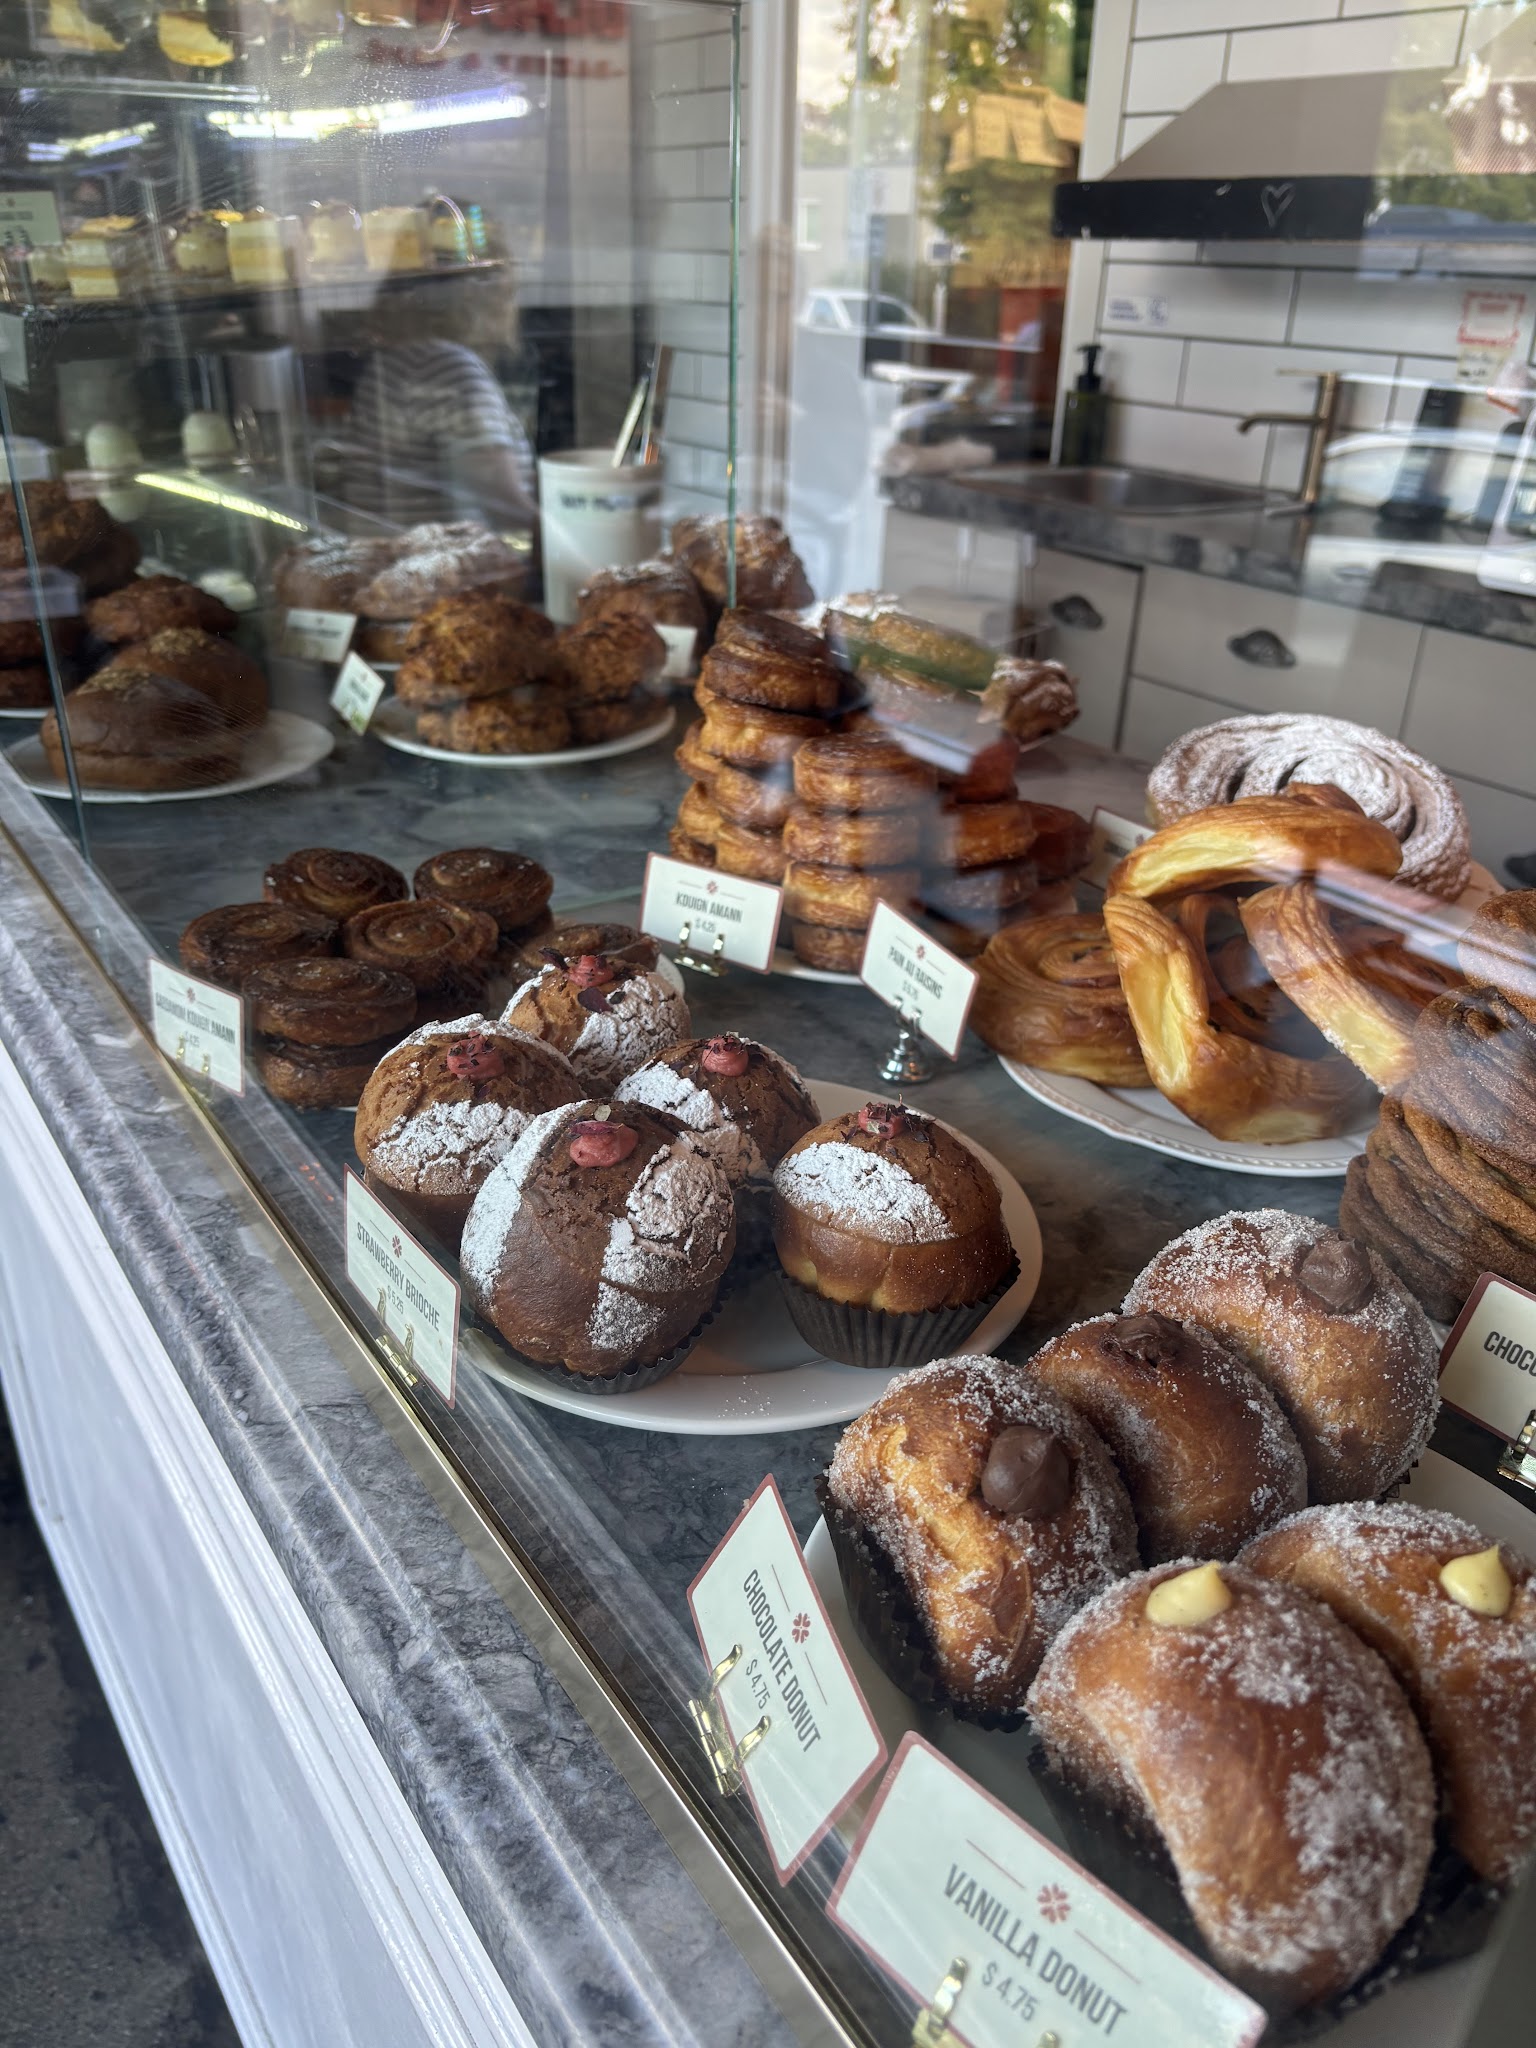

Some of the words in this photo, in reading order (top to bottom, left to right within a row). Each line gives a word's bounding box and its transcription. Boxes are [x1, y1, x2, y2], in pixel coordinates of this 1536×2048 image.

[709, 902, 743, 923] AMANN
[915, 967, 943, 1000] RAISINS
[356, 1221, 405, 1290] STRAWBERRY
[405, 1276, 440, 1332] BRIOCHE
[392, 1290, 404, 1315] 5.25
[743, 1568, 792, 1686] CHOCOLATE
[780, 1673, 823, 1753] DONUT
[745, 1657, 758, 1677] $
[751, 1671, 771, 1709] 4.75
[942, 1863, 1040, 1969] VANILLA
[1037, 1945, 1128, 2035] DONUT
[981, 1961, 998, 1986] $
[996, 1974, 1039, 2022] 4.75
